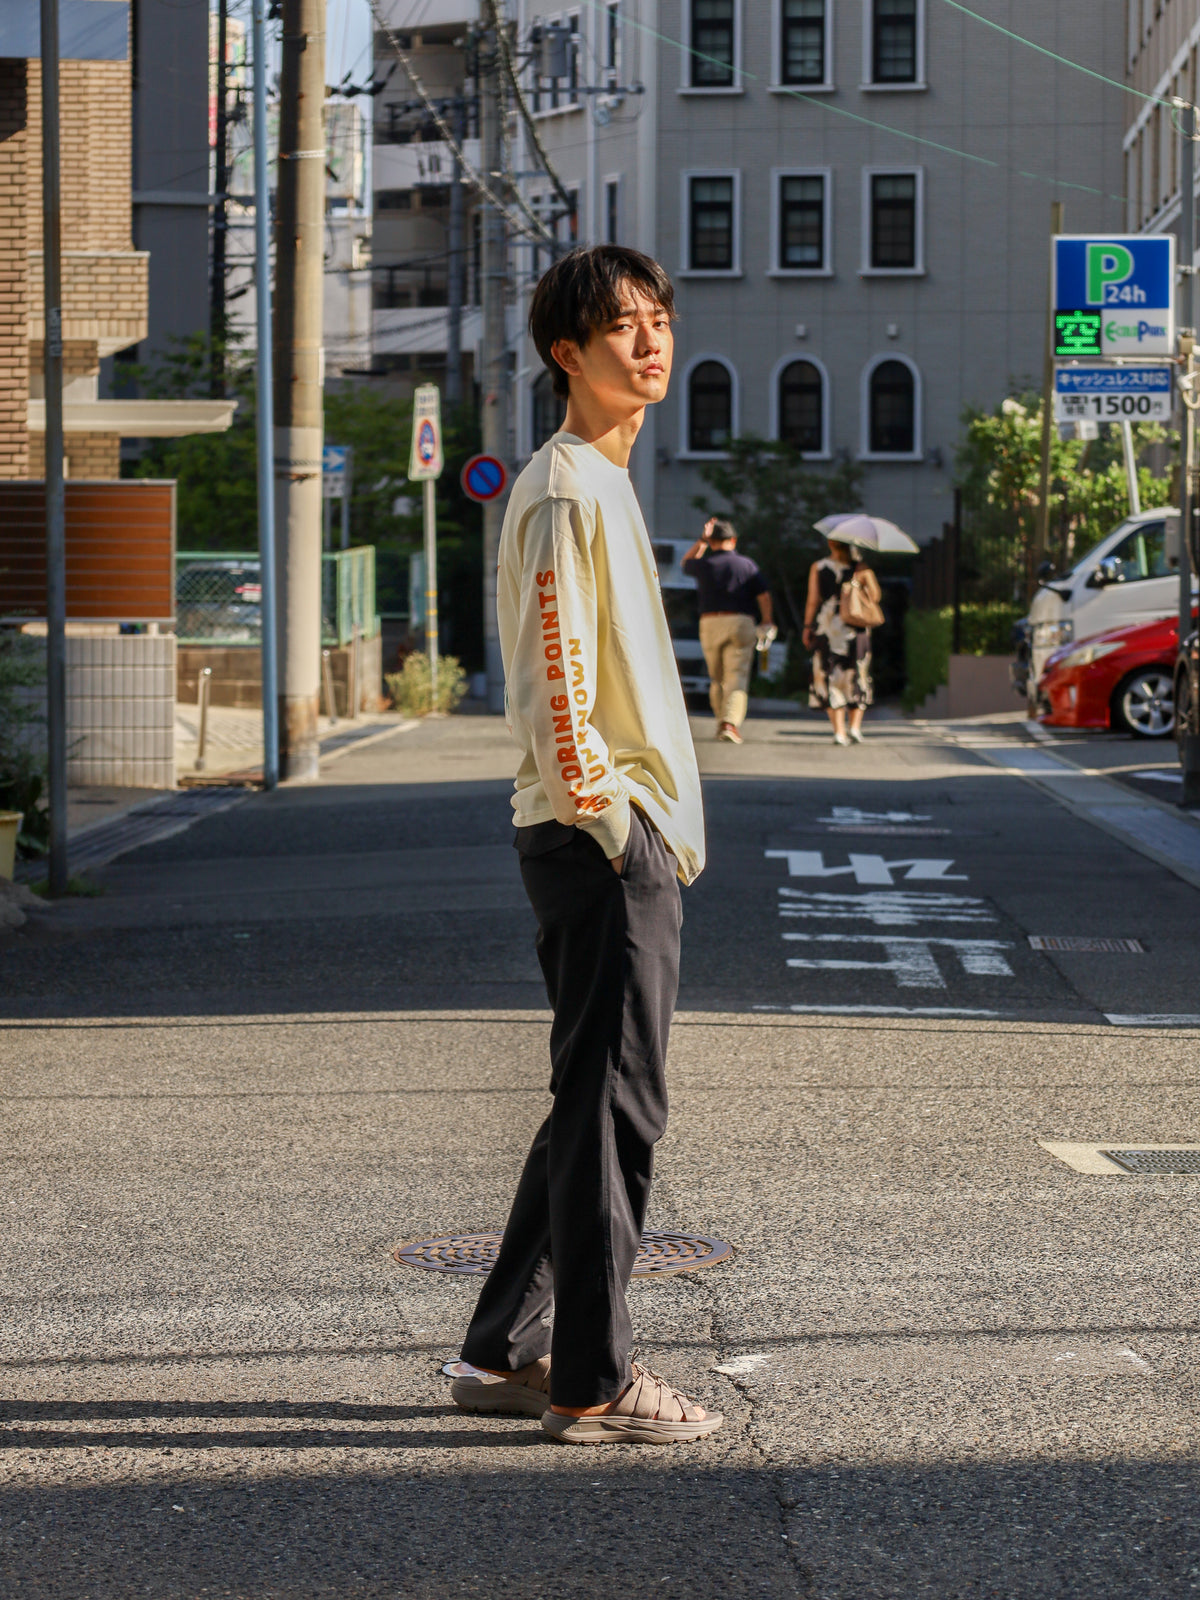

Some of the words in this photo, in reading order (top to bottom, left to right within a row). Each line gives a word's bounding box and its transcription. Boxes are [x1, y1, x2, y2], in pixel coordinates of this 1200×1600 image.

[1085, 242, 1135, 305] P
[1106, 284, 1147, 304] 24h
[1055, 310, 1101, 355] 空
[535, 569, 566, 682] POINTS
[568, 638, 606, 783] UNKNOWN
